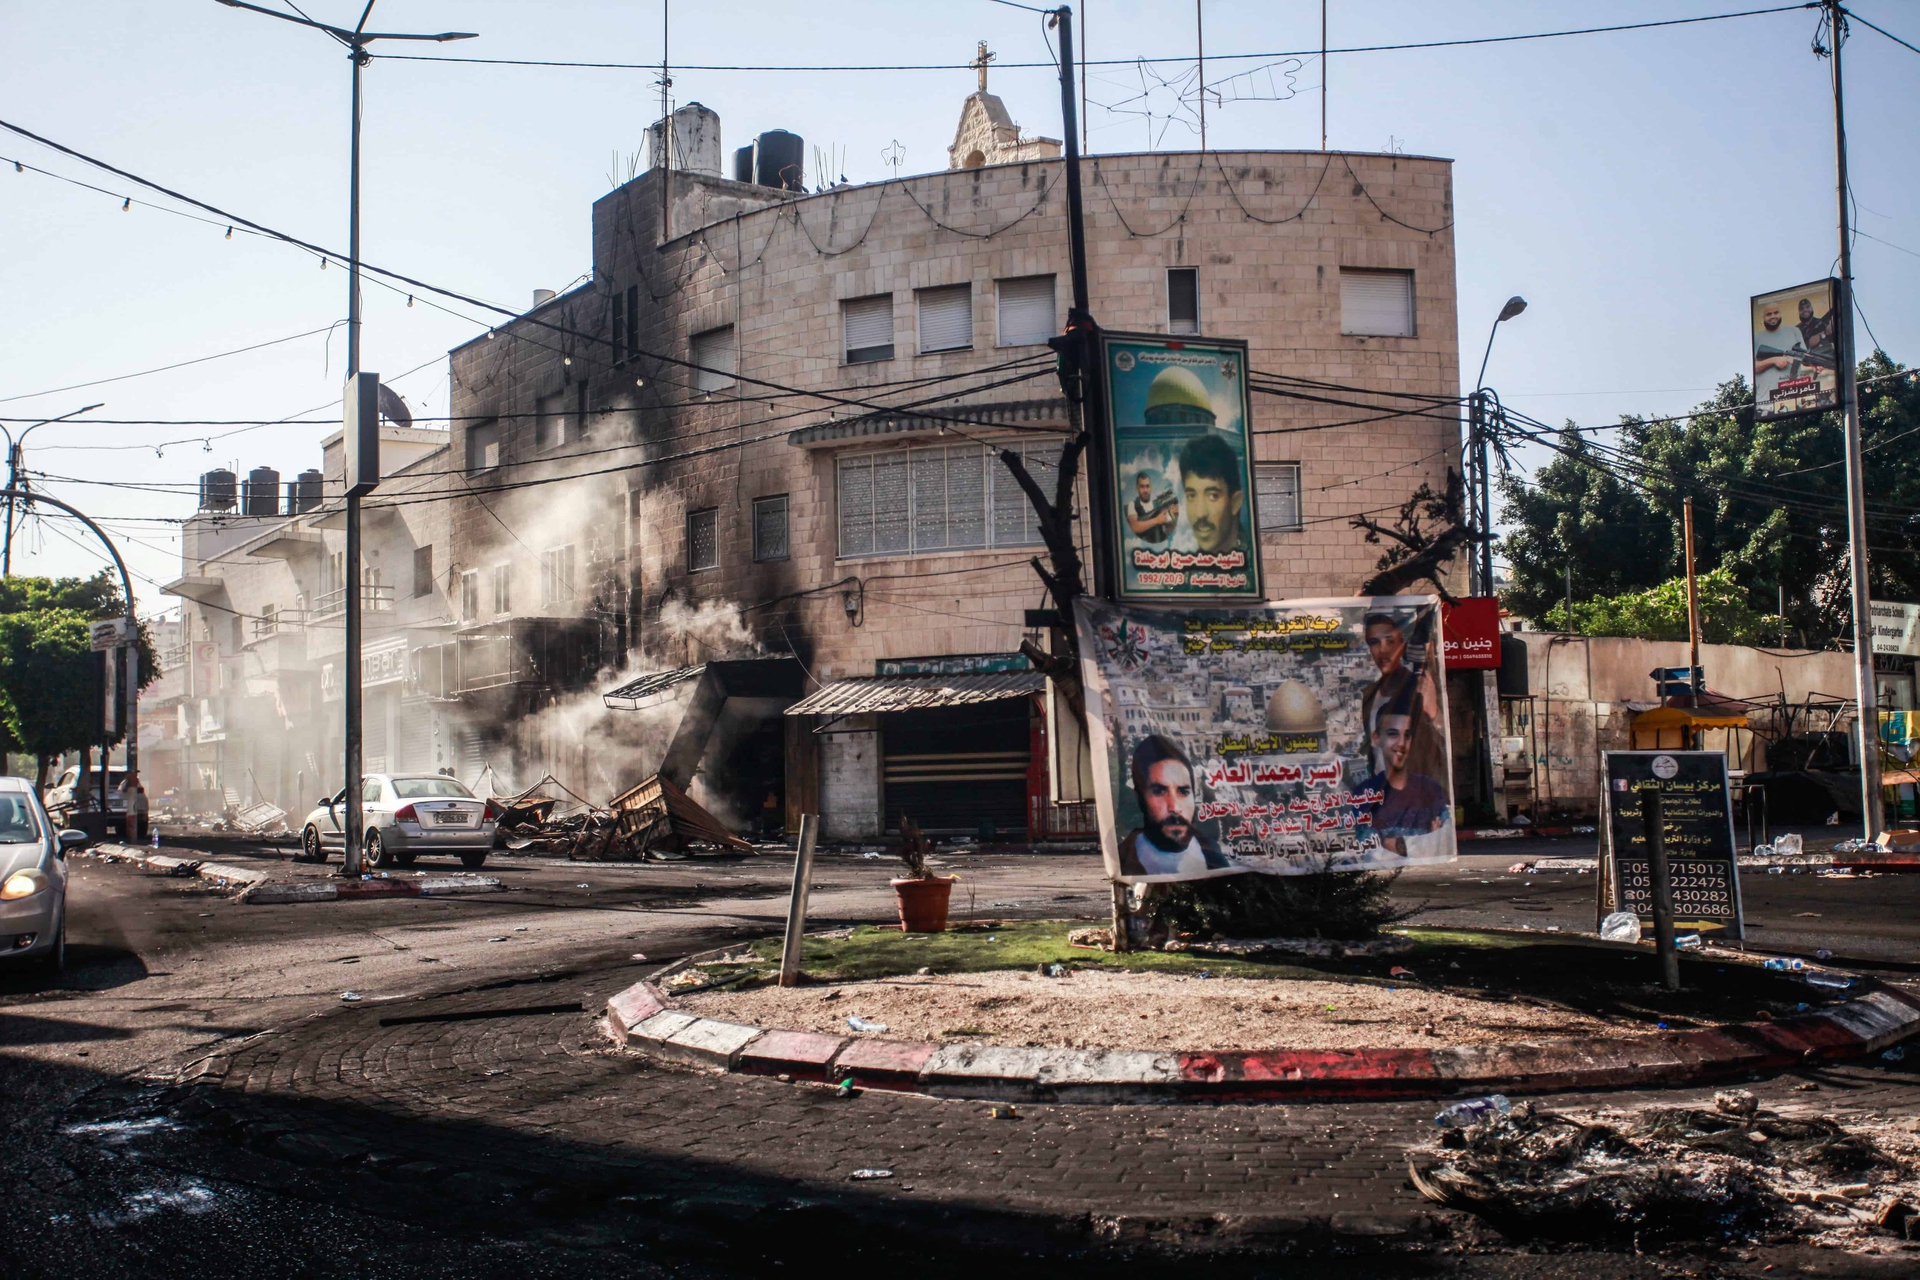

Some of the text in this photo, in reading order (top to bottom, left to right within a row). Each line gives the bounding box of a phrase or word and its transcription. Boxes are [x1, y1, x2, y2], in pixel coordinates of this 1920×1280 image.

[1158, 551, 1170, 569] ابو
[1172, 552, 1196, 568] حسين
[1196, 553, 1215, 567] حمد
[1217, 551, 1244, 570] الشهيد
[1226, 573, 1246, 587] تاريخ
[1869, 604, 1892, 617] atriarchate
[1184, 616, 1339, 638] حركة التحرير الوطني الفلسطيني فتح
[1183, 636, 1207, 655] جنين
[1209, 638, 1233, 655] مخيم
[1243, 636, 1267, 653] العامر
[1270, 637, 1288, 653] زياد
[1289, 636, 1318, 653] الشهيد
[1318, 636, 1349, 650] منطقة
[1463, 637, 1493, 651] جنين
[1217, 735, 1250, 755] البطل
[1252, 735, 1282, 755] الاسير
[1207, 759, 1342, 788] ايسر محمد العامر
[1630, 778, 1720, 793] مركز بيسان الثقافي
[1197, 789, 1385, 822] بمناسبة الافراج عنه من سجون الاحتلال
[1302, 814, 1313, 831] 7
[1357, 811, 1373, 826] بعد
[1227, 820, 1254, 841] الاسر
[1257, 819, 1270, 839] في
[1272, 819, 1302, 836] سنوات
[1227, 833, 1382, 860] الحرية لكافة الاسرى والمعتقلين
[1664, 835, 1682, 844] التربي
[1683, 835, 1702, 844] وزارة
[1702, 835, 1712, 844] من
[1632, 863, 1725, 875] 05715012
[1632, 876, 1726, 888] 05222475
